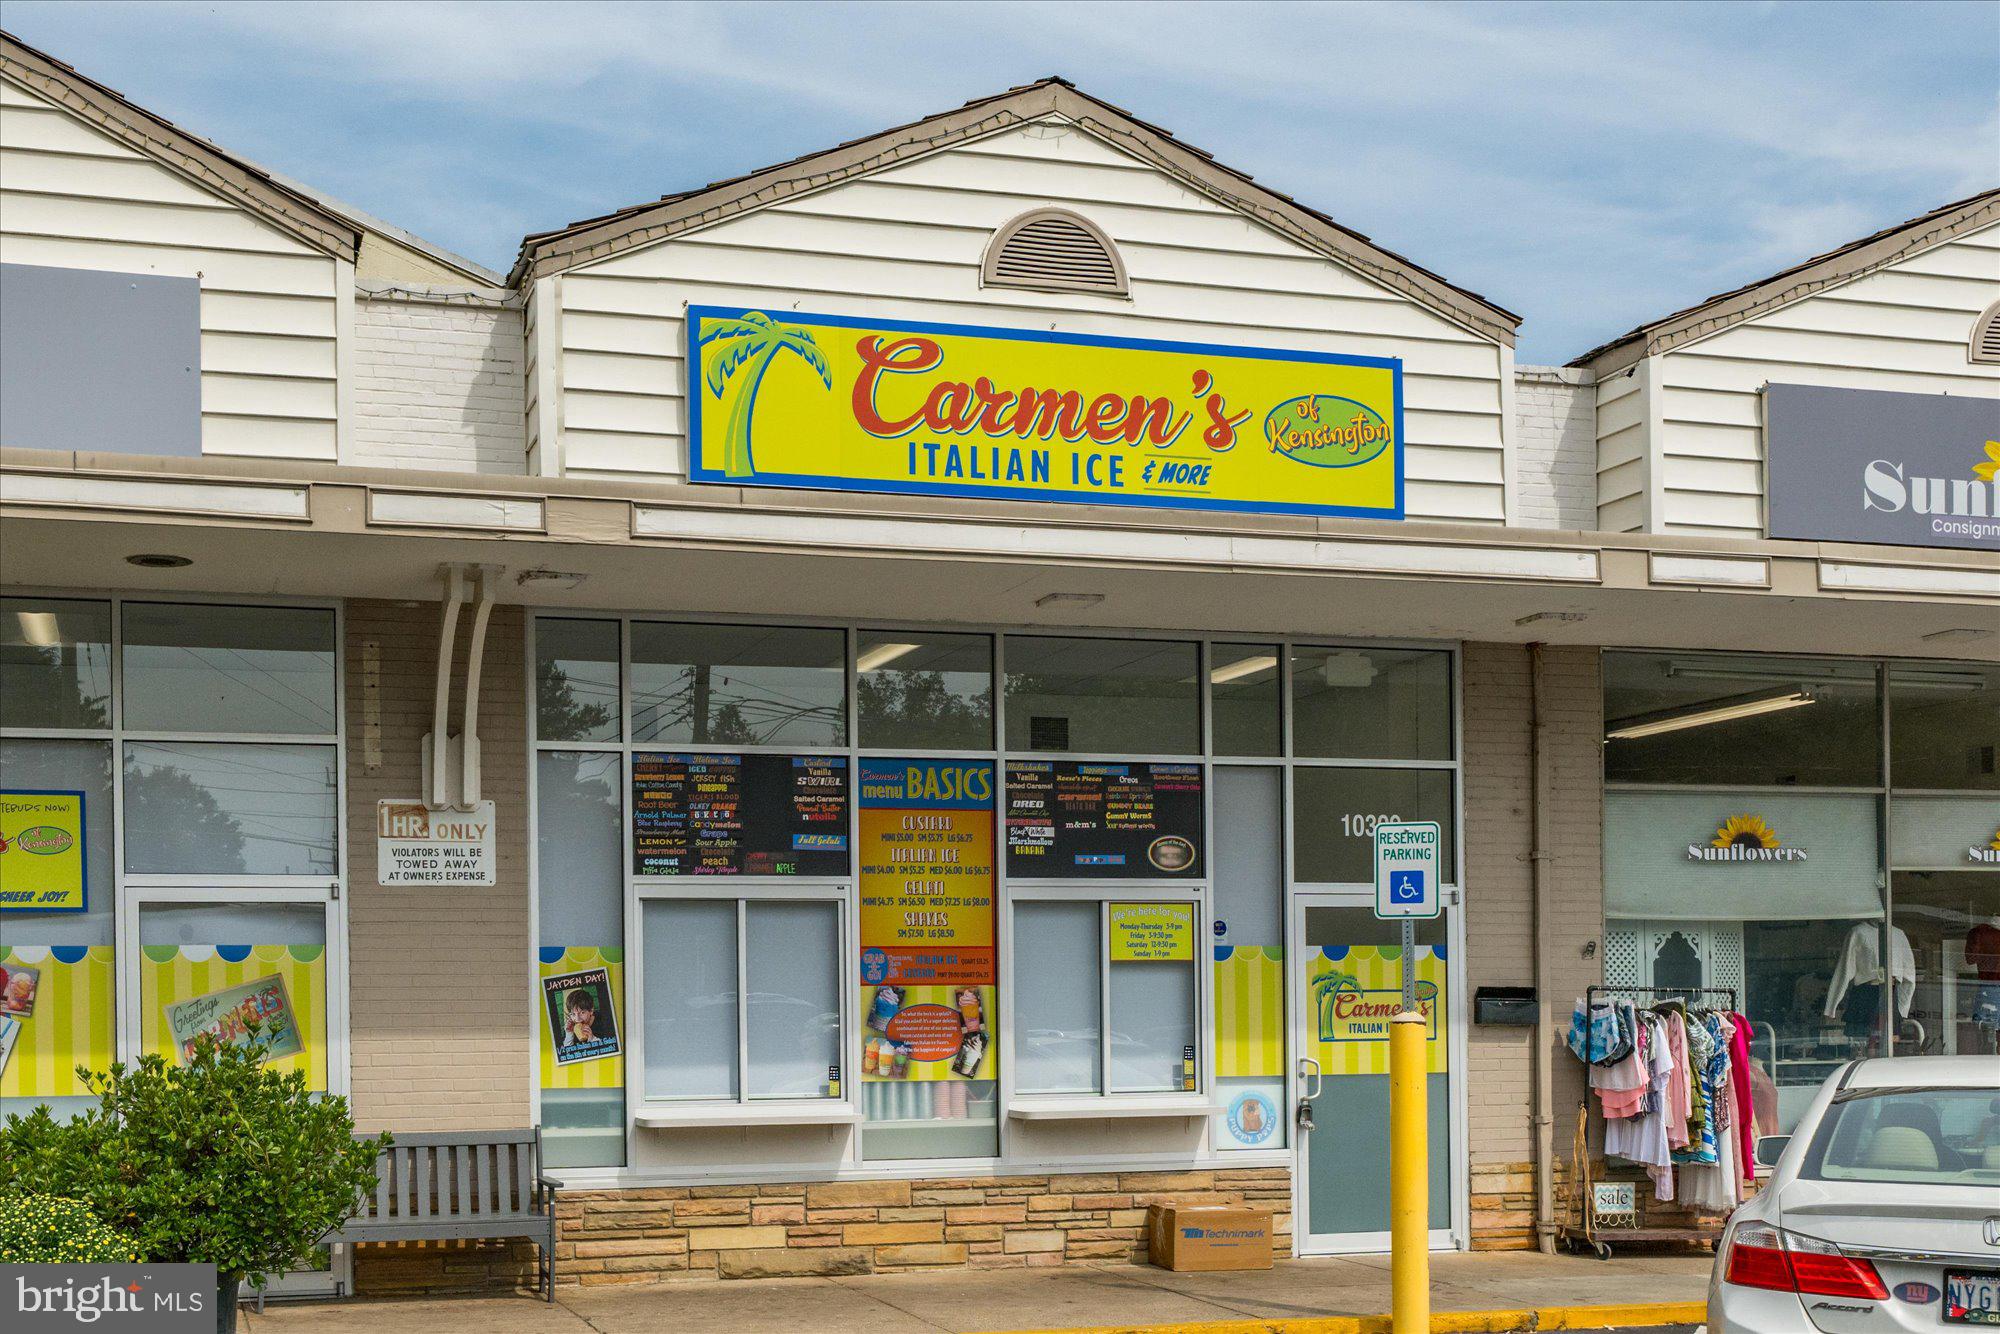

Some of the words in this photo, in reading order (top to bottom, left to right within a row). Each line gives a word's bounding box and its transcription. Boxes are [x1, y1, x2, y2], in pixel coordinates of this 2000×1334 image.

[852, 334, 1253, 452] Carmen's
[1296, 394, 1319, 423] of
[1268, 415, 1391, 454] Kensington
[908, 442, 1050, 483] ITALIAN
[1072, 453, 1125, 487] ICE
[1142, 460, 1156, 483] &
[1158, 462, 1212, 485] MORE
[907, 767, 992, 800] BASICS
[863, 785, 903, 799] menu
[1012, 800, 1045, 808] OREO
[902, 816, 953, 830] CUSTARD
[436, 823, 487, 840] ONLY
[1380, 832, 1435, 845] RESERVED
[391, 848, 439, 857] VIOLATORS
[443, 848, 466, 857] WILL
[469, 848, 482, 857] BE
[891, 848, 937, 862] ITALIAN
[942, 849, 960, 863] ICE
[1015, 845, 1046, 855] BANANA
[1383, 848, 1432, 861] PARKING
[1688, 842, 1808, 862] Sunflowers
[396, 859, 438, 869] TOWED
[444, 860, 478, 869] AWAY
[388, 872, 398, 881] AT
[403, 872, 443, 881] OWNERS
[446, 872, 486, 881] EXPENSE
[905, 880, 945, 895] GELATI
[904, 911, 949, 928] SHAKES
[546, 976, 583, 991] JAYDEN
[585, 972, 606, 984] DAY!
[1335, 993, 1432, 1020] Carme's
[1349, 1023, 1383, 1034] ITALIAN
[1600, 1189, 1628, 1205] sale
[1205, 1228, 1266, 1239] Technimark
[1949, 1283, 2000, 1311] NYG
[1810, 1302, 1874, 1313] Accord
